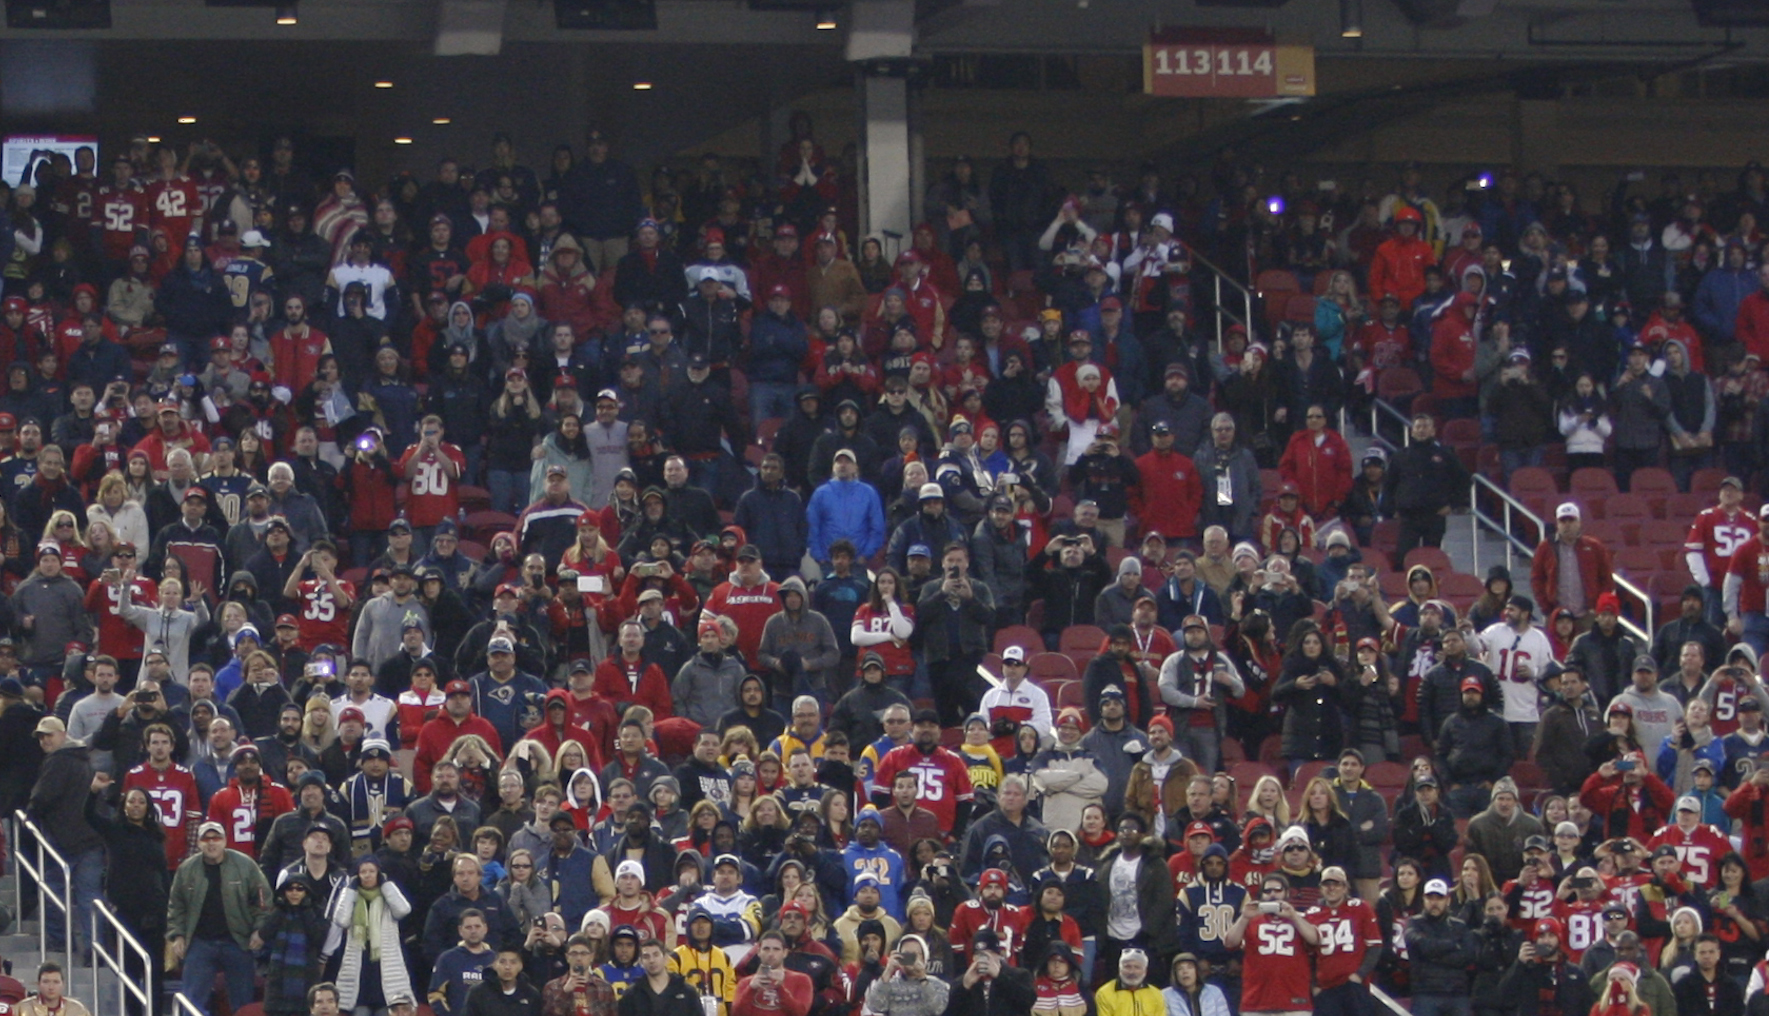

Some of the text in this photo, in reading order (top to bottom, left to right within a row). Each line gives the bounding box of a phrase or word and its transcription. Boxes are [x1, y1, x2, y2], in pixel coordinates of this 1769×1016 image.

[1155, 50, 1272, 74] 113 114
[105, 202, 134, 231] 52
[156, 190, 187, 216] 42
[1713, 525, 1752, 558] 52
[304, 592, 336, 623] 35
[1497, 648, 1532, 684] 16
[1519, 890, 1553, 919] 52
[1198, 904, 1234, 941] 30
[1318, 919, 1355, 955] 94
[1568, 912, 1603, 950] 81
[1258, 923, 1295, 956] 52
